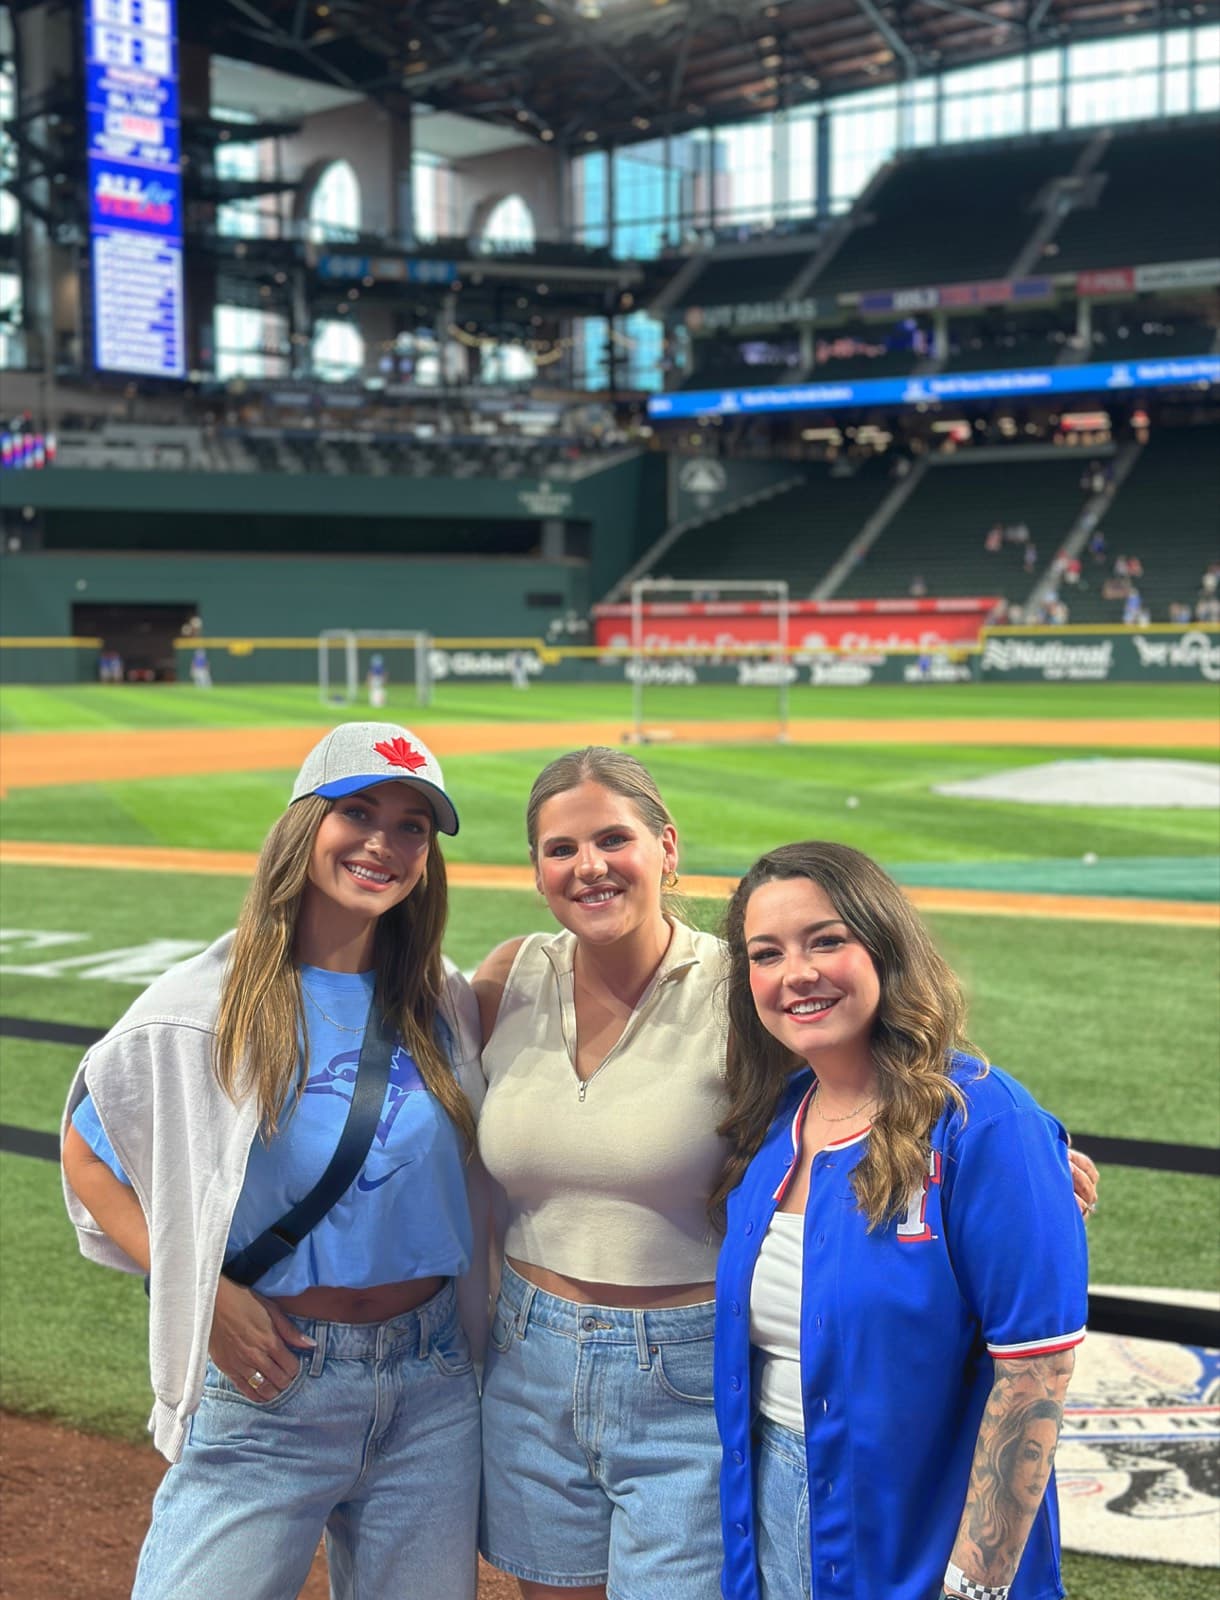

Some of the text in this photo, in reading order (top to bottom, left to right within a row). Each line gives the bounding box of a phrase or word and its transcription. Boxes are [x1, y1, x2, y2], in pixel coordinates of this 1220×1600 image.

[97, 194, 173, 224] TEXAS
[735, 299, 816, 323] DALLAS
[1014, 640, 1113, 668] National
